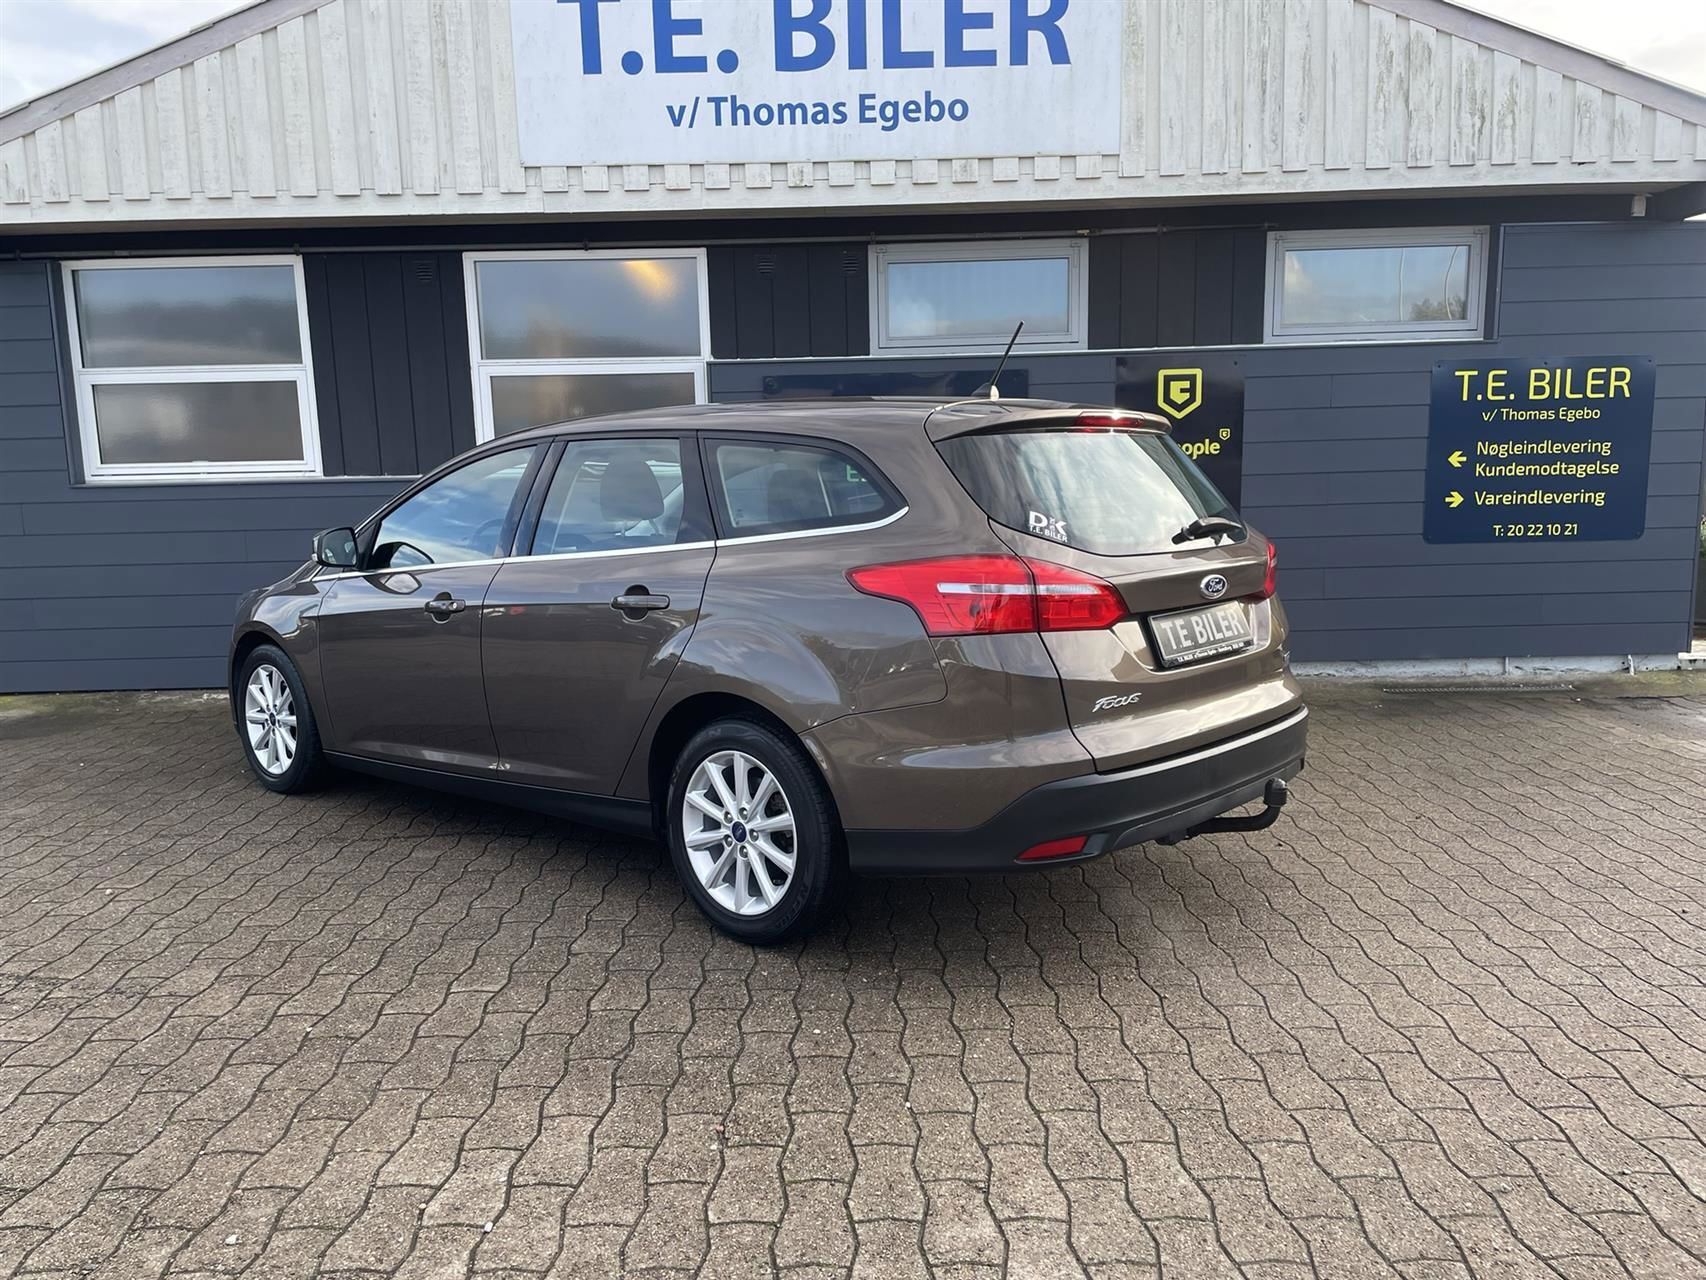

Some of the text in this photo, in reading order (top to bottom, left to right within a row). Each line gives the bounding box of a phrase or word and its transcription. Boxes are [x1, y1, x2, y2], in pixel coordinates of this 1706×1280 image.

[557, 0, 1072, 75] T.E. BILER
[707, 95, 848, 127] Thomas
[858, 91, 970, 132] Egebo
[1455, 366, 1632, 401] T.E. BILER
[1500, 407, 1556, 421] Thomas
[1558, 406, 1601, 423] Egebo
[1476, 439, 1612, 458] Nøgleindlevering
[1475, 460, 1620, 478] Kundemodtagelse
[1474, 489, 1606, 507] Vareindlevering
[1044, 528, 1068, 543] BILER
[1493, 522, 1578, 537] T: 20 22 10 21
[1190, 606, 1245, 645] BILER
[1091, 692, 1142, 713] Focus
